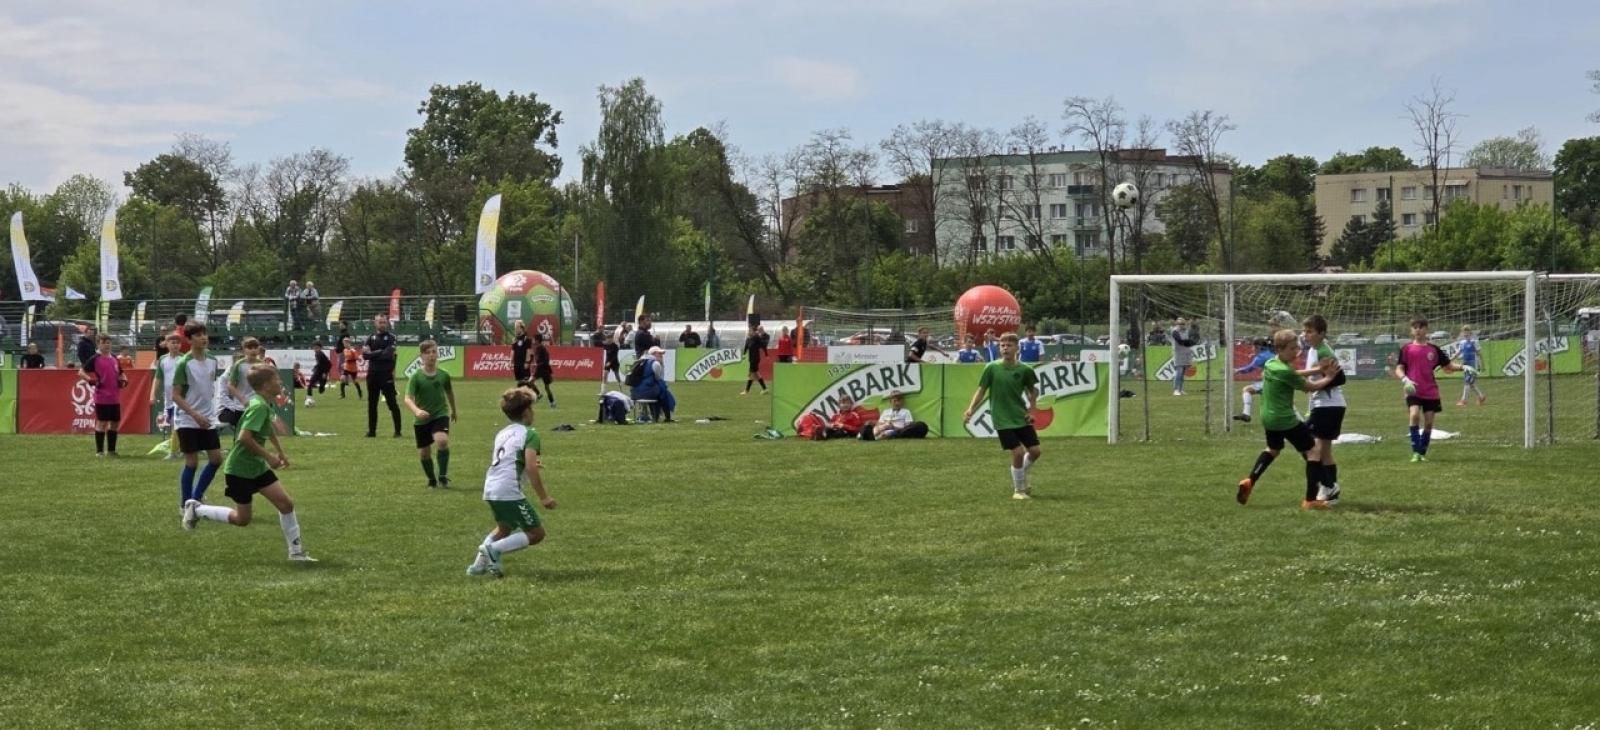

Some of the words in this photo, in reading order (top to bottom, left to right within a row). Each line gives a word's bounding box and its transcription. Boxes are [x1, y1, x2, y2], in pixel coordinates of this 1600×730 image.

[688, 349, 739, 380] TYMBARK
[828, 363, 851, 378] 1936
[812, 363, 915, 422] YMBARK
[973, 362, 1090, 435] TARK
